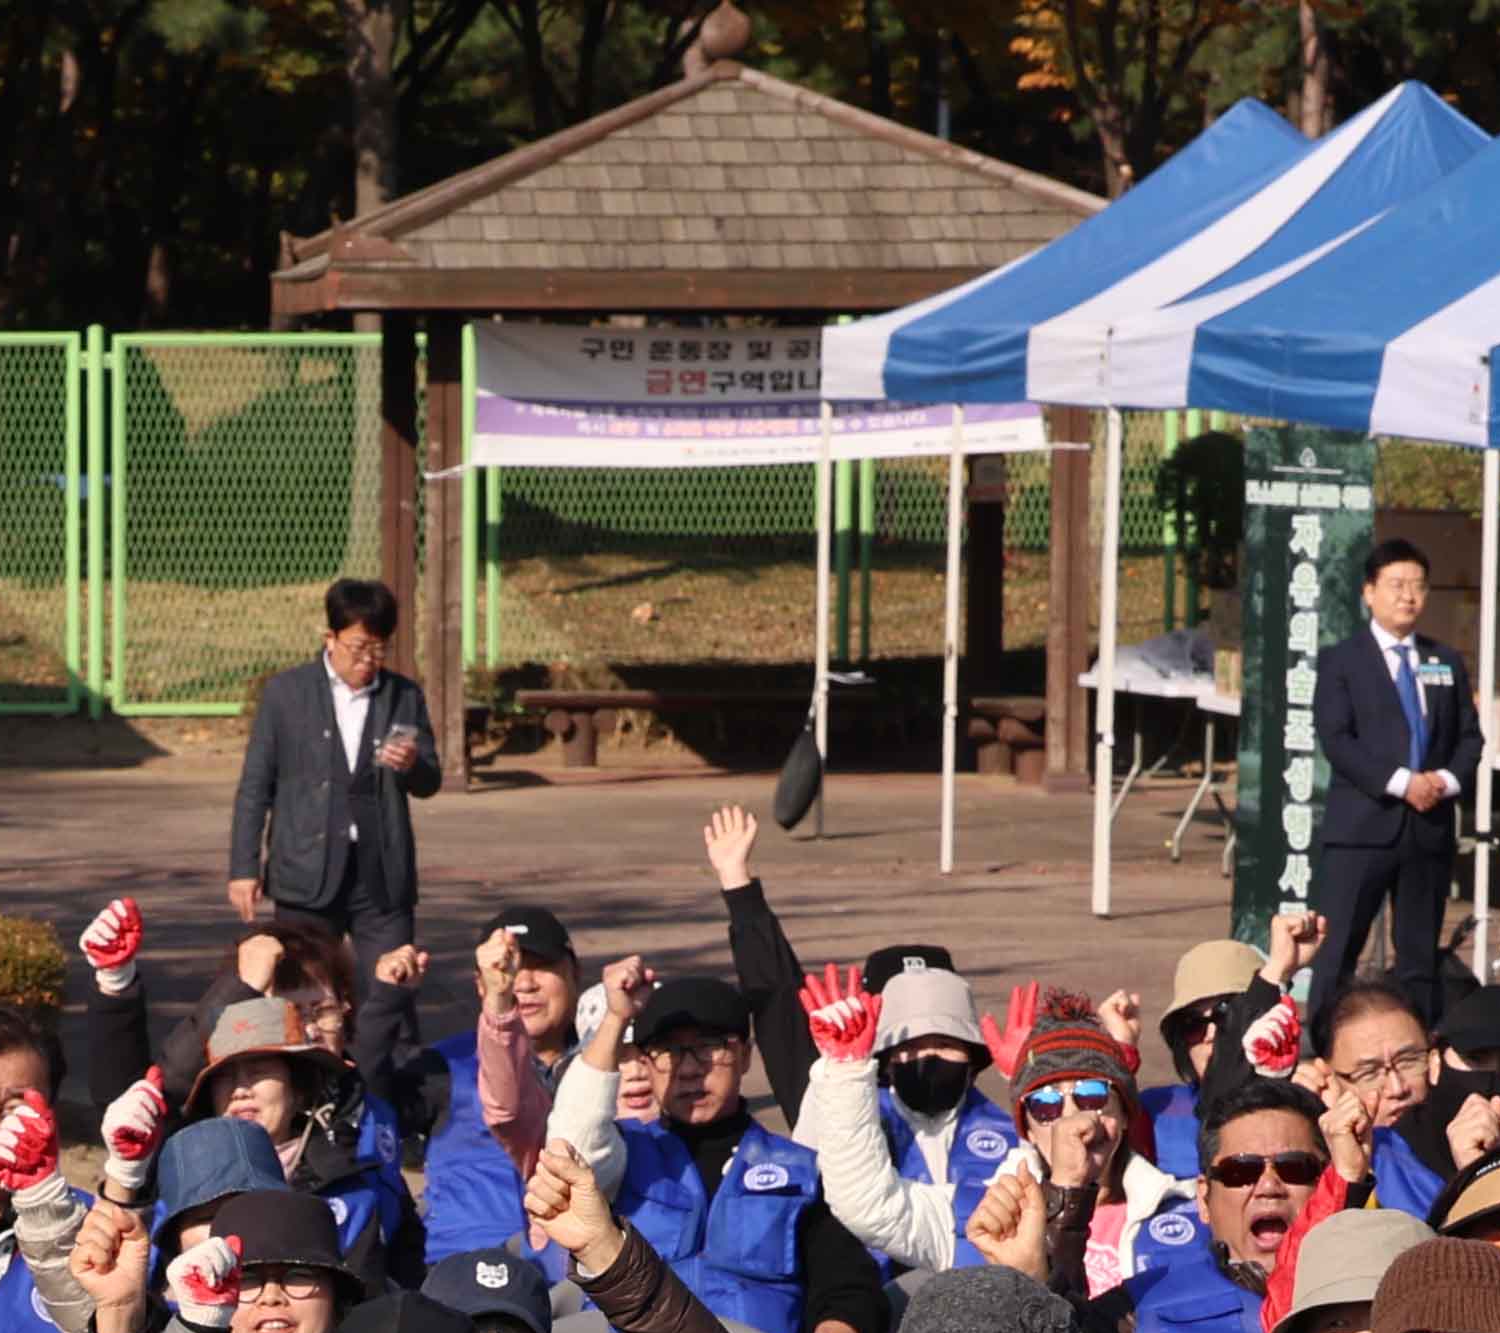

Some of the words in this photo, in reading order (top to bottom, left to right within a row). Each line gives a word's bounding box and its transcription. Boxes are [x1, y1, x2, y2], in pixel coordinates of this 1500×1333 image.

[787, 338, 821, 361] 공
[646, 367, 821, 395] 금연구역입니
[1278, 514, 1323, 915] 자유의숲조성행사
